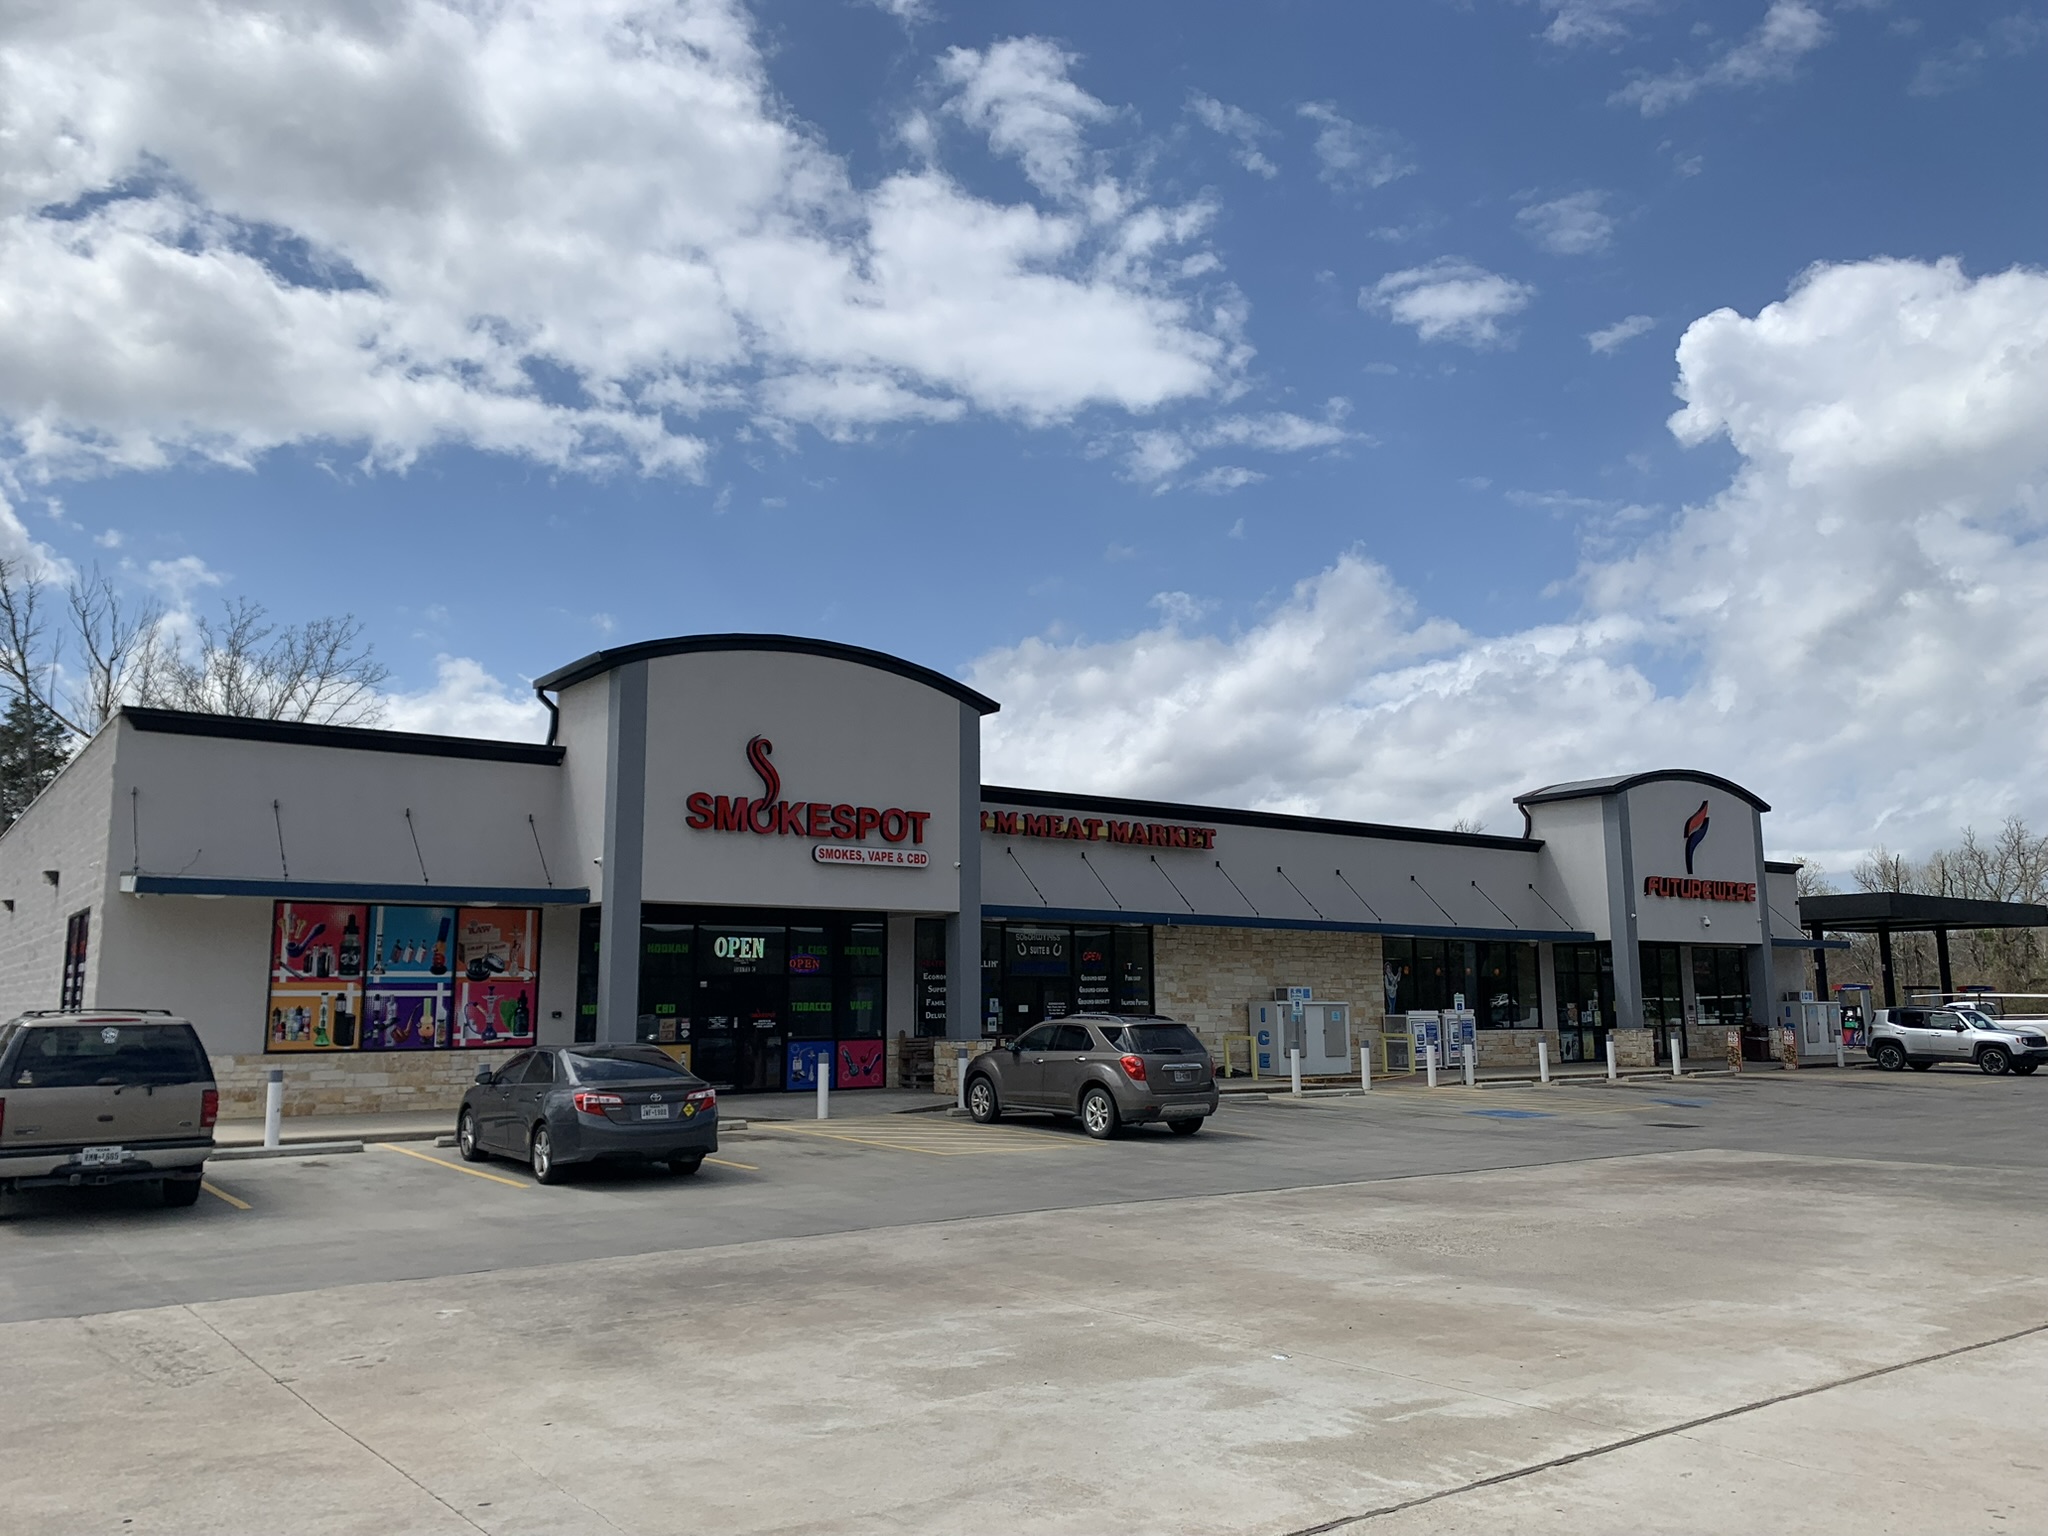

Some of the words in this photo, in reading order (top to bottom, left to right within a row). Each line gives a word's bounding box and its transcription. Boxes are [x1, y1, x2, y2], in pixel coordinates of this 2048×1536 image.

[686, 792, 931, 845] SMOKESPOT
[993, 810, 1018, 834] M
[1023, 813, 1103, 841] MEAT
[1106, 820, 1217, 850] MARKET
[818, 848, 865, 863] SMOKES,
[868, 851, 894, 862] VAPE
[896, 853, 904, 863] &
[907, 854, 927, 865] CBD
[1644, 876, 1756, 902] FUTUREWISE
[467, 925, 492, 935] RAW
[714, 936, 765, 959] OPEN
[1029, 945, 1045, 955] SUITE
[789, 959, 820, 969] OPEN
[792, 1002, 832, 1011] TOBACCO
[850, 1001, 873, 1010] VAPE
[925, 998, 946, 1006] FAMIL
[655, 1003, 676, 1014] CBD
[1257, 1007, 1271, 1069] ICE
